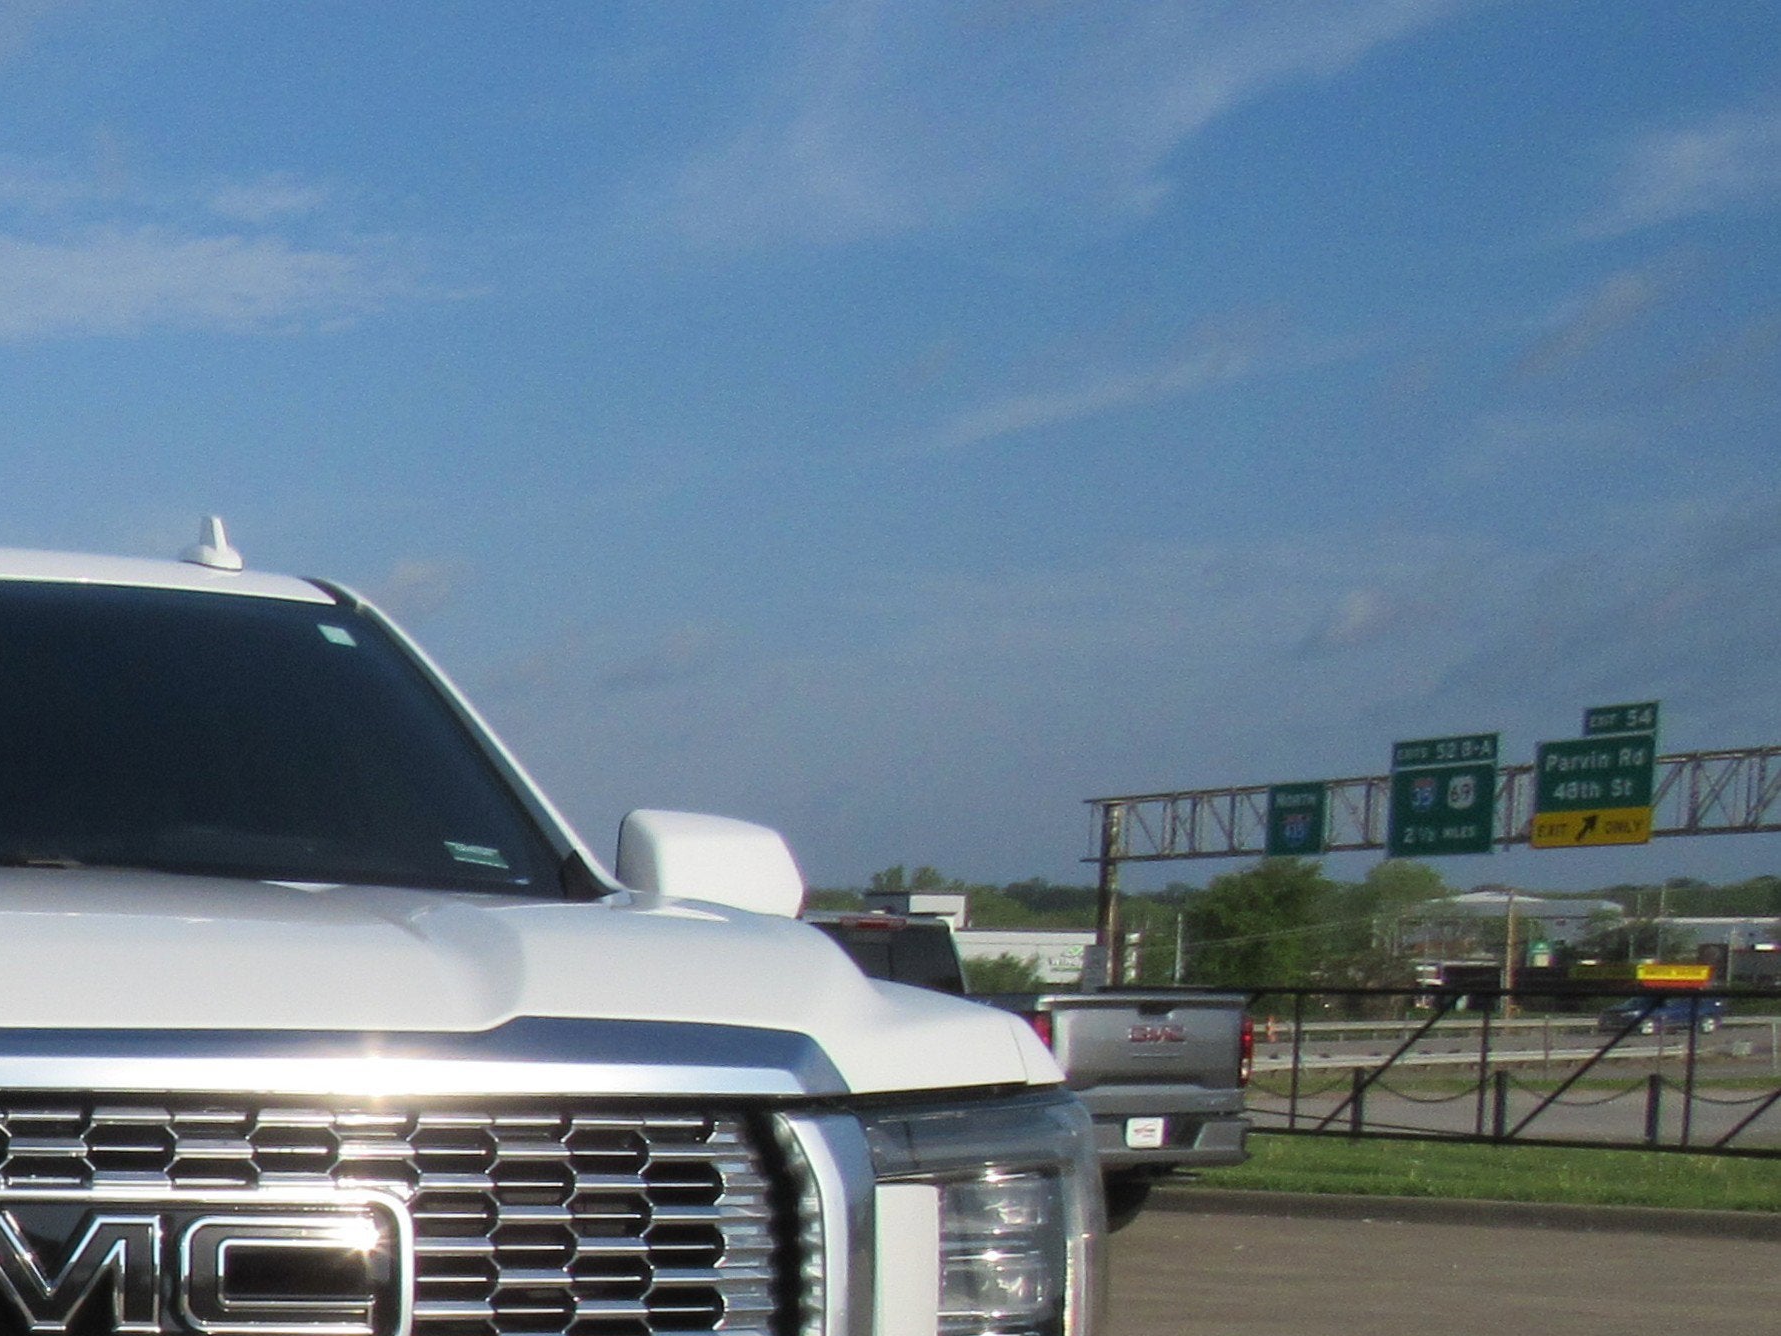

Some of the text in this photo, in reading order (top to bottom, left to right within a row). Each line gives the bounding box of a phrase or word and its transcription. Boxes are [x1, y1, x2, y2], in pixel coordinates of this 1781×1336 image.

[1589, 709, 1654, 728] EXIT 54
[1436, 742, 1456, 759] 52
[1546, 748, 1646, 771] Parvin Rd
[1554, 778, 1633, 799] 48th St
